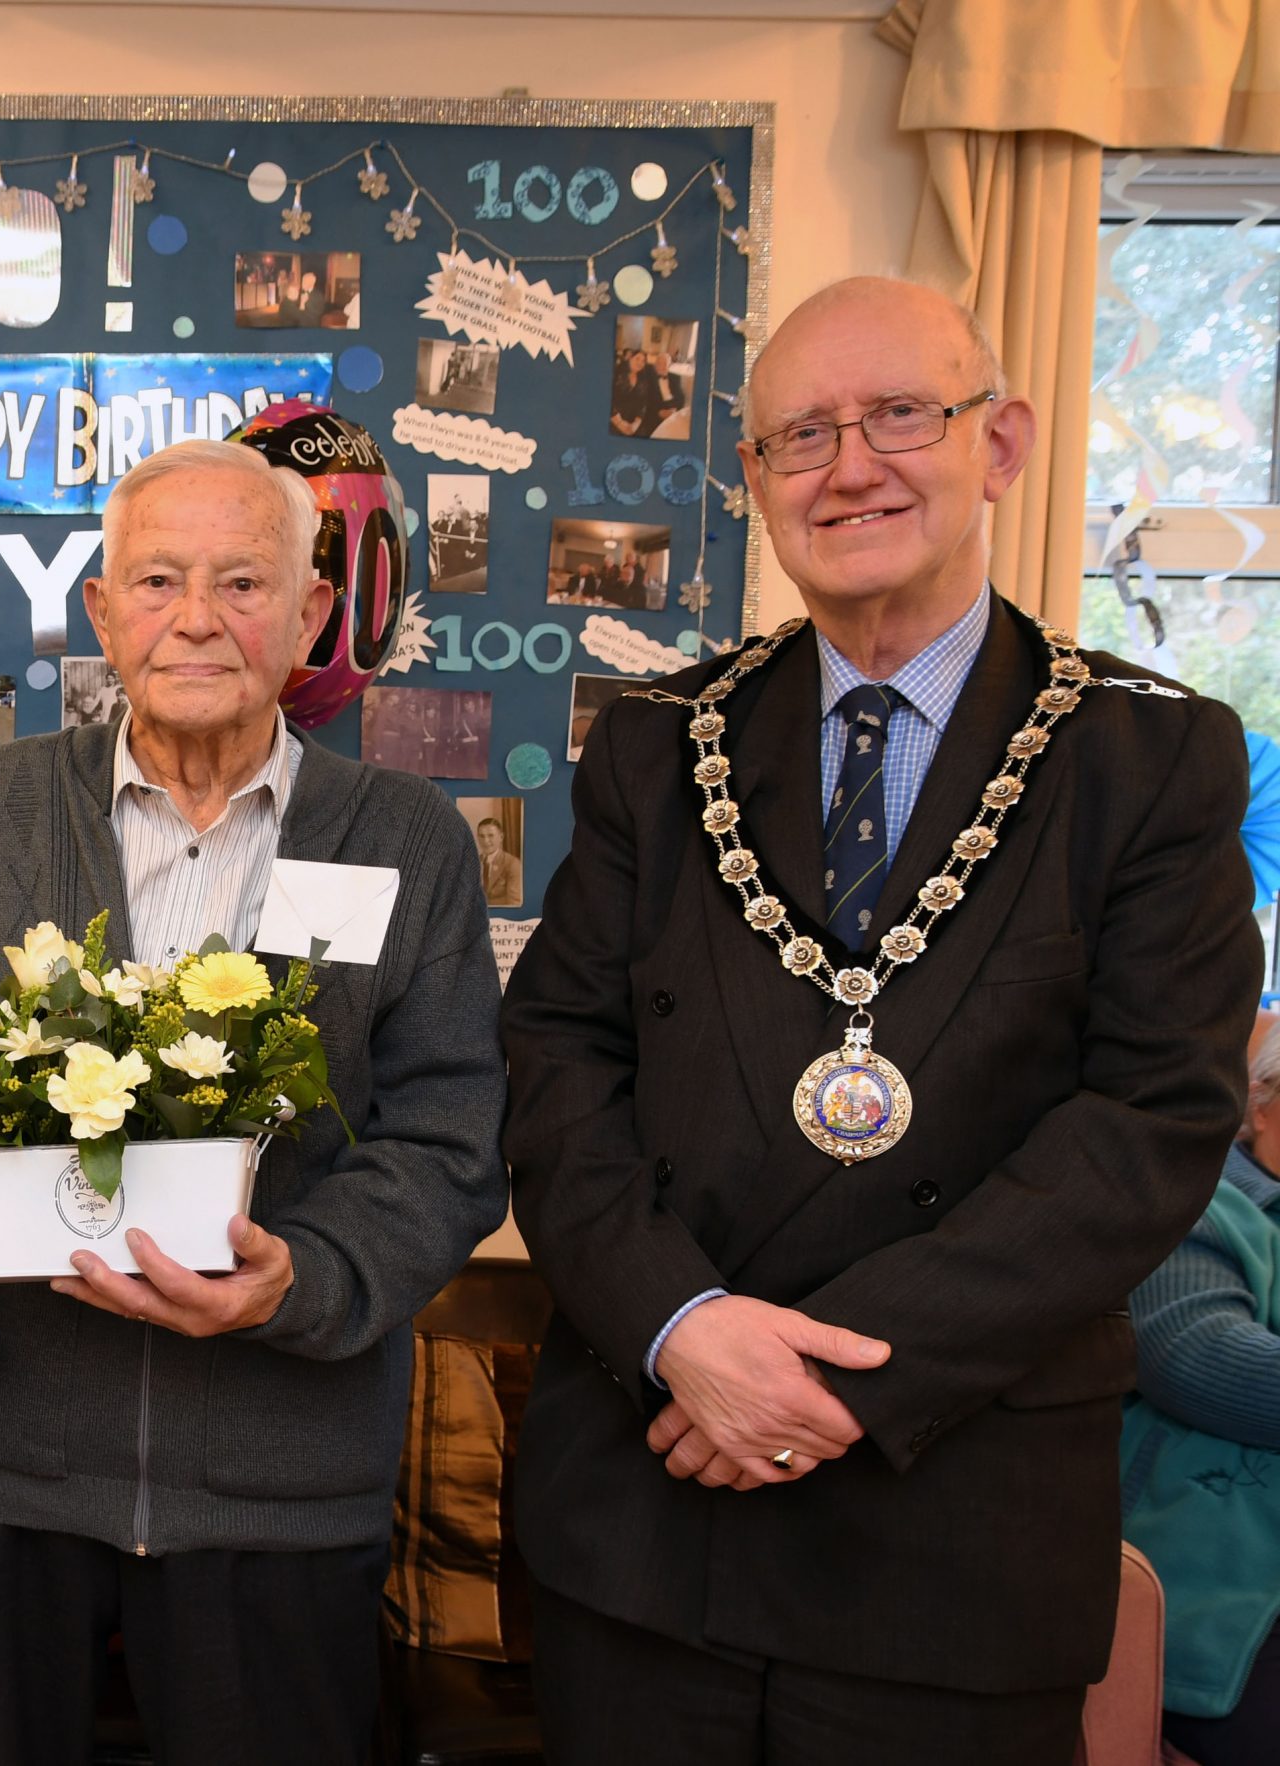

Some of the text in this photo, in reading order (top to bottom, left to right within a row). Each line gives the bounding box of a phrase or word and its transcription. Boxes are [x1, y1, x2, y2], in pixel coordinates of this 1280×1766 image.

[467, 159, 620, 226] 100
[455, 266, 479, 279] HEN
[480, 275, 492, 286] HE
[524, 293, 556, 312] YOUNG
[469, 287, 489, 300] THEY
[523, 309, 542, 322] PIGS
[436, 303, 452, 315] ON
[452, 309, 469, 321] THE
[451, 294, 561, 344] ADDER TO PLAY FOOTBALL
[399, 430, 411, 438] he
[412, 433, 433, 445] used
[435, 438, 444, 447] to
[446, 441, 467, 454] drive
[476, 448, 494, 460] Milk
[402, 416, 428, 430] When
[430, 423, 455, 438] Elwyn
[457, 431, 473, 440] was
[490, 439, 513, 450] years
[514, 444, 529, 454] old
[559, 448, 706, 506] 100
[430, 614, 572, 674] 100
[589, 640, 639, 664] open top car
[595, 625, 676, 665] Elwyn's favourite car
